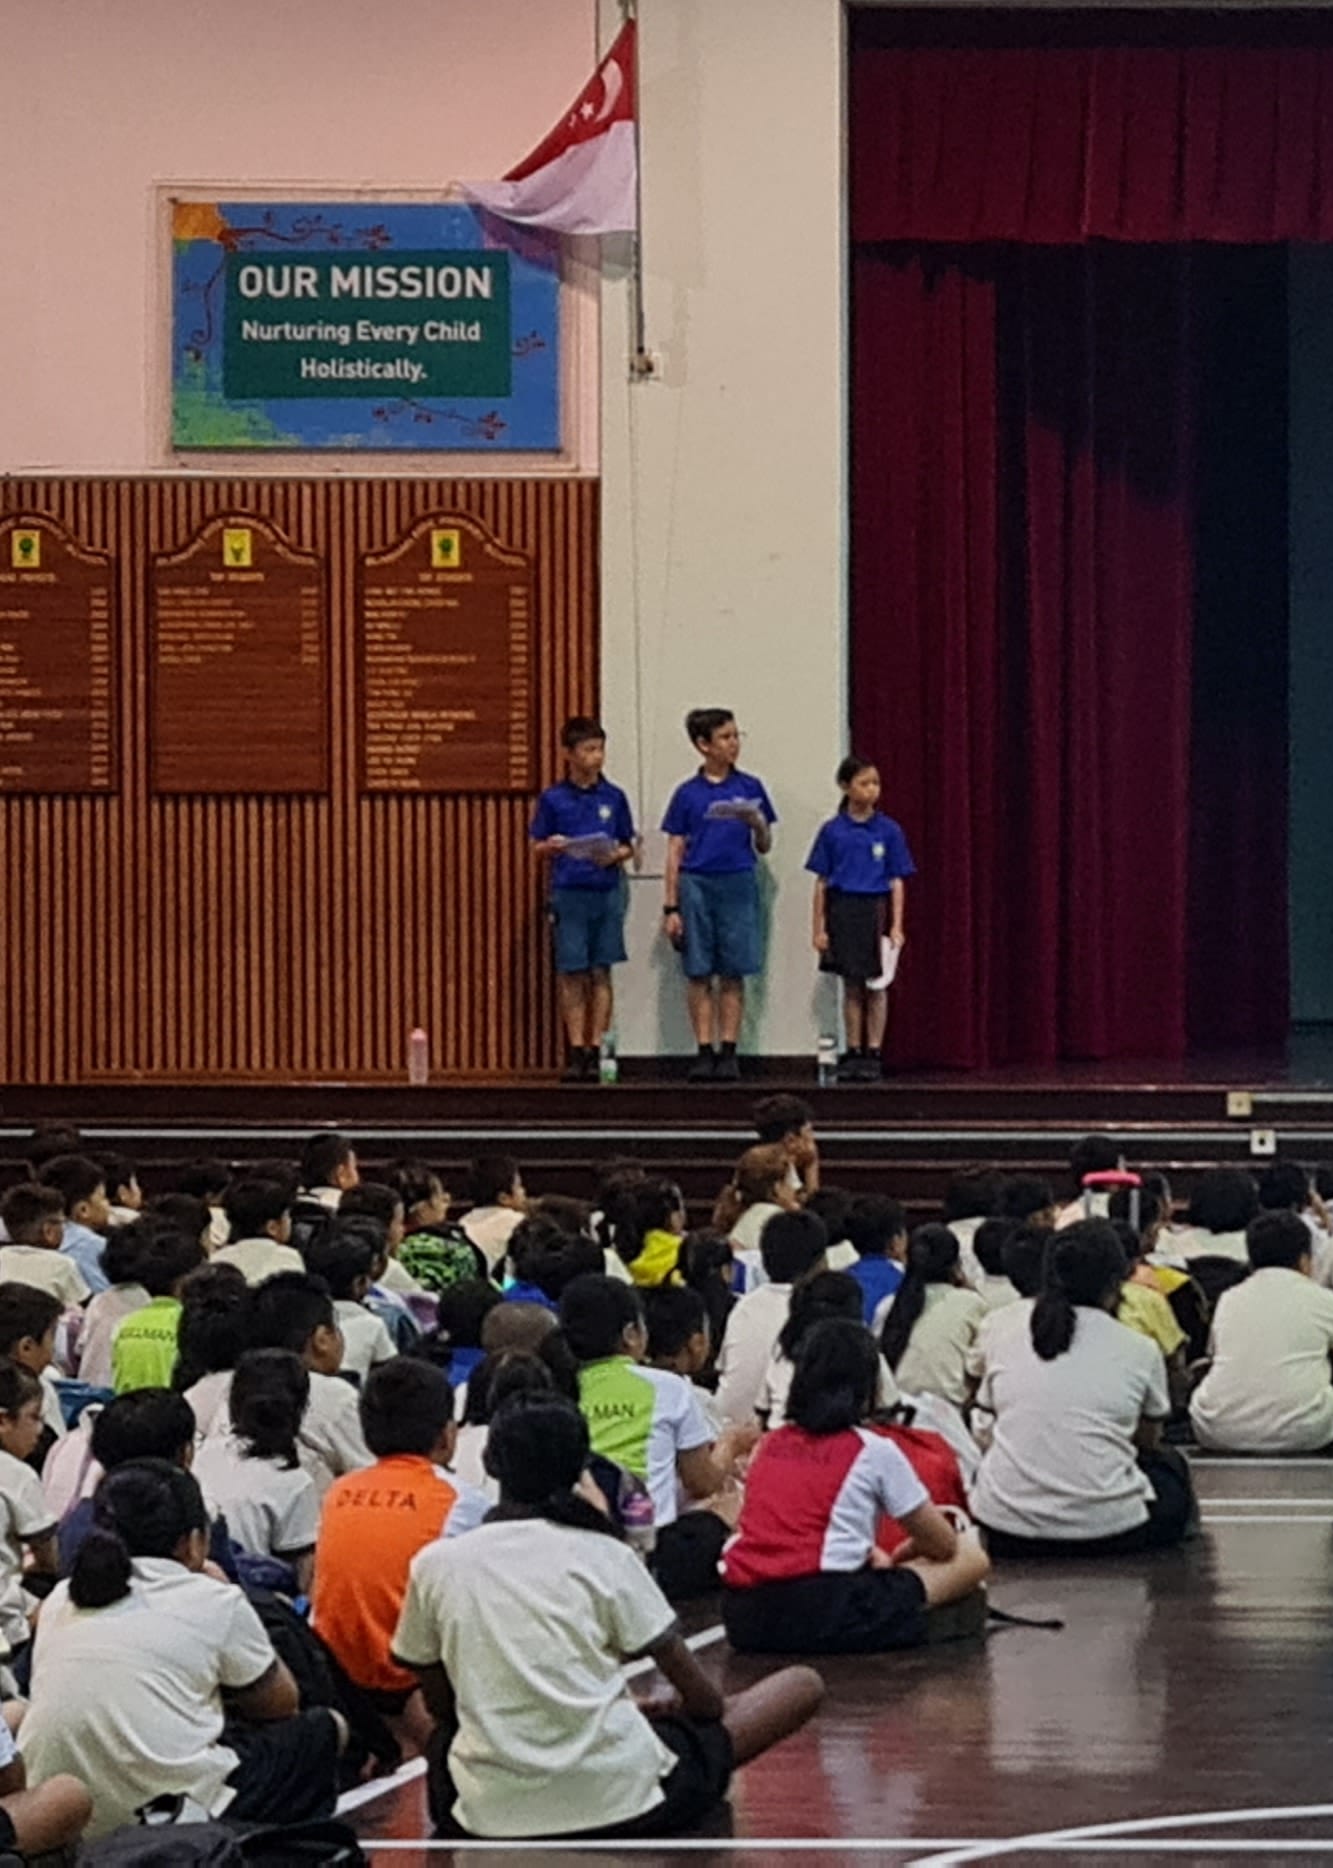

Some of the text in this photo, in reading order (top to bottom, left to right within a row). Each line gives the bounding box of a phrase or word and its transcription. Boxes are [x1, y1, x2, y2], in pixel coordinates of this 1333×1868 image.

[239, 265, 492, 298] OUR MISSION
[242, 320, 481, 345] Nurturing Every Child
[300, 358, 428, 383] Holistically.
[336, 1489, 417, 1511] DELTA
